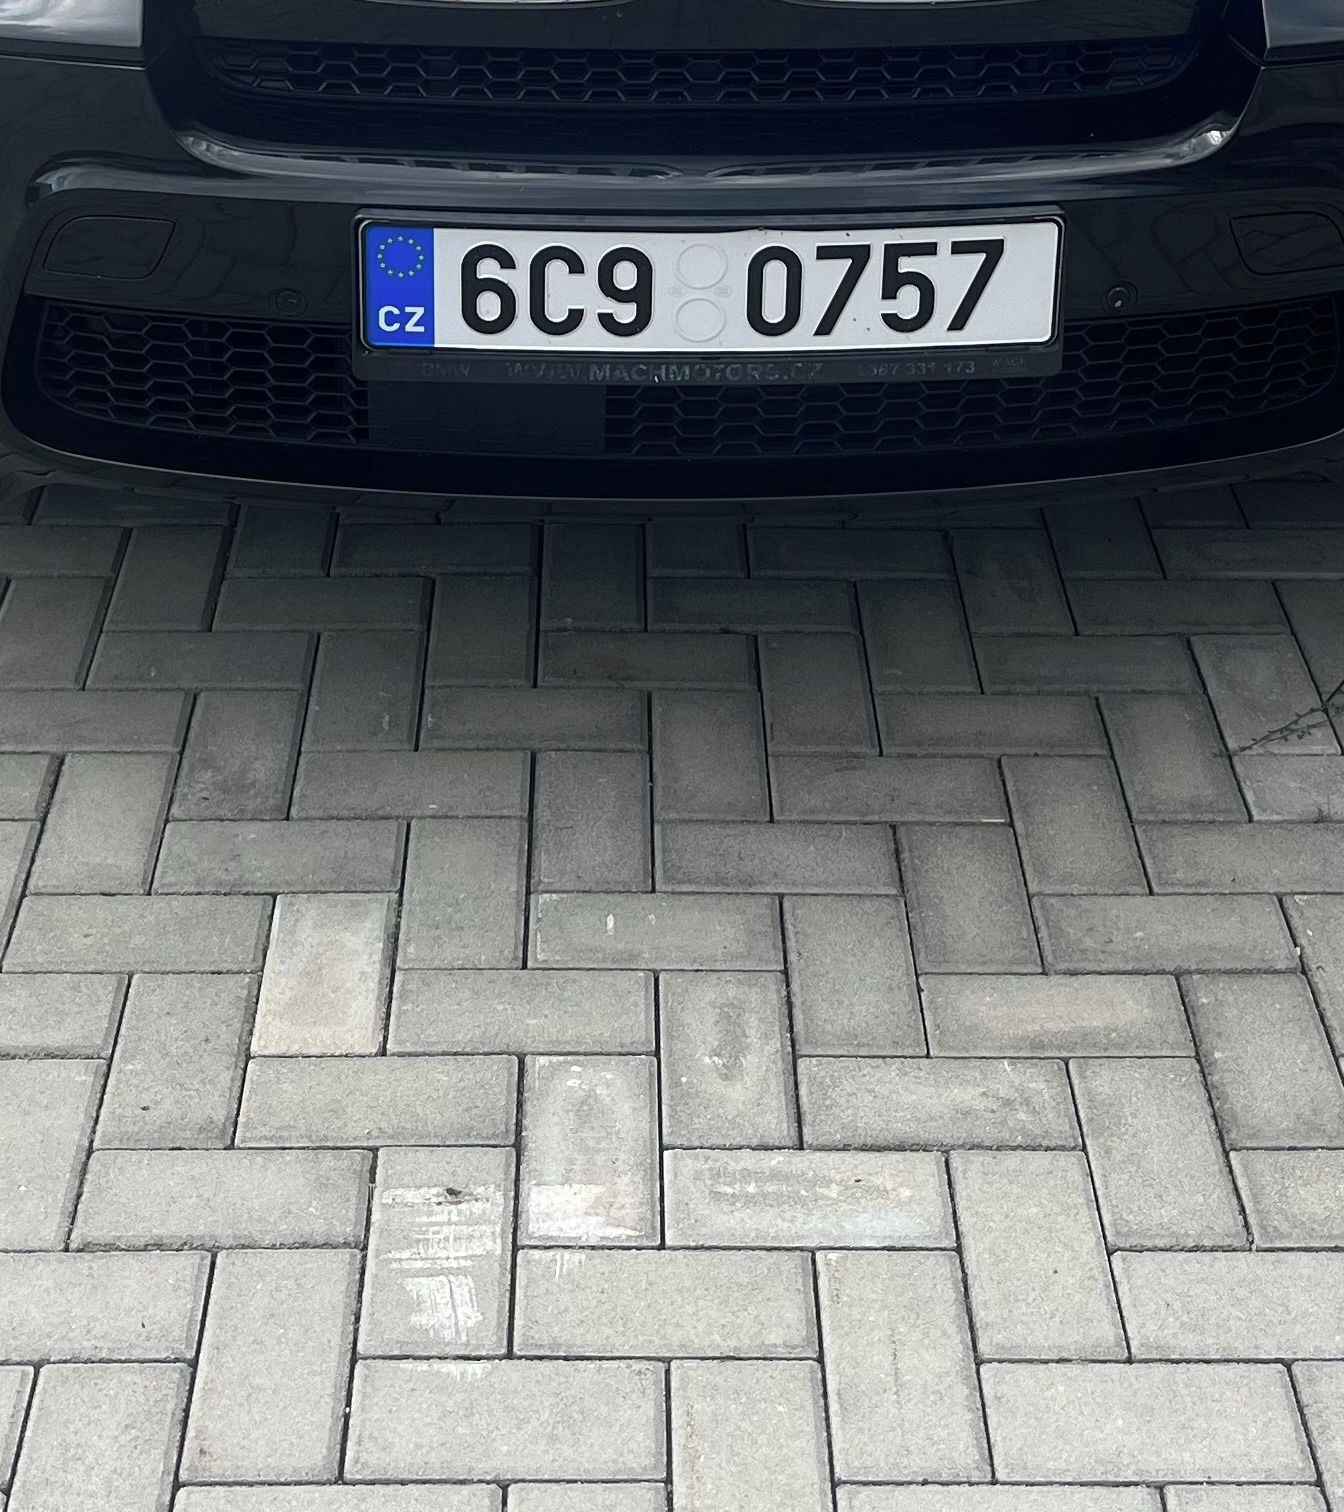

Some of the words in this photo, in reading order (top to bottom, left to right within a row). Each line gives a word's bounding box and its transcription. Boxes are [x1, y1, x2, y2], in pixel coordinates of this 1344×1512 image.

[377, 304, 426, 334] CZ
[459, 242, 654, 337] 6C9
[745, 238, 1005, 336] 0757
